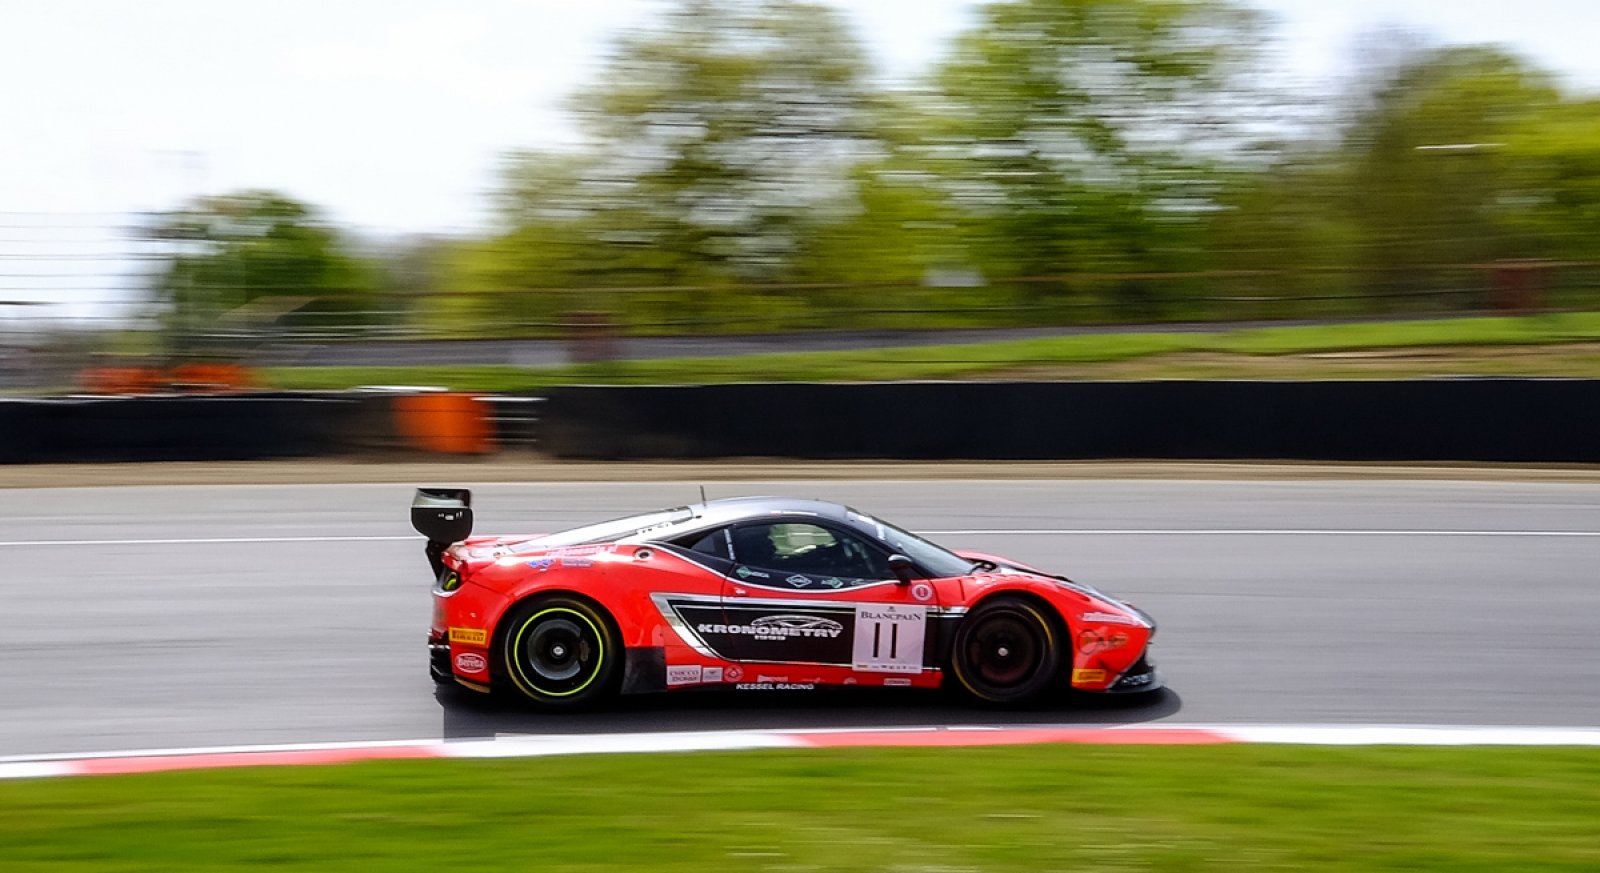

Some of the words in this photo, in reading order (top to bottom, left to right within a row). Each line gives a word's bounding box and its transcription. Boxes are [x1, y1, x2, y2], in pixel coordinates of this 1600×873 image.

[861, 611, 921, 620] BLANCPAIN
[697, 623, 842, 638] KRONOMETRY
[872, 622, 898, 659] 11
